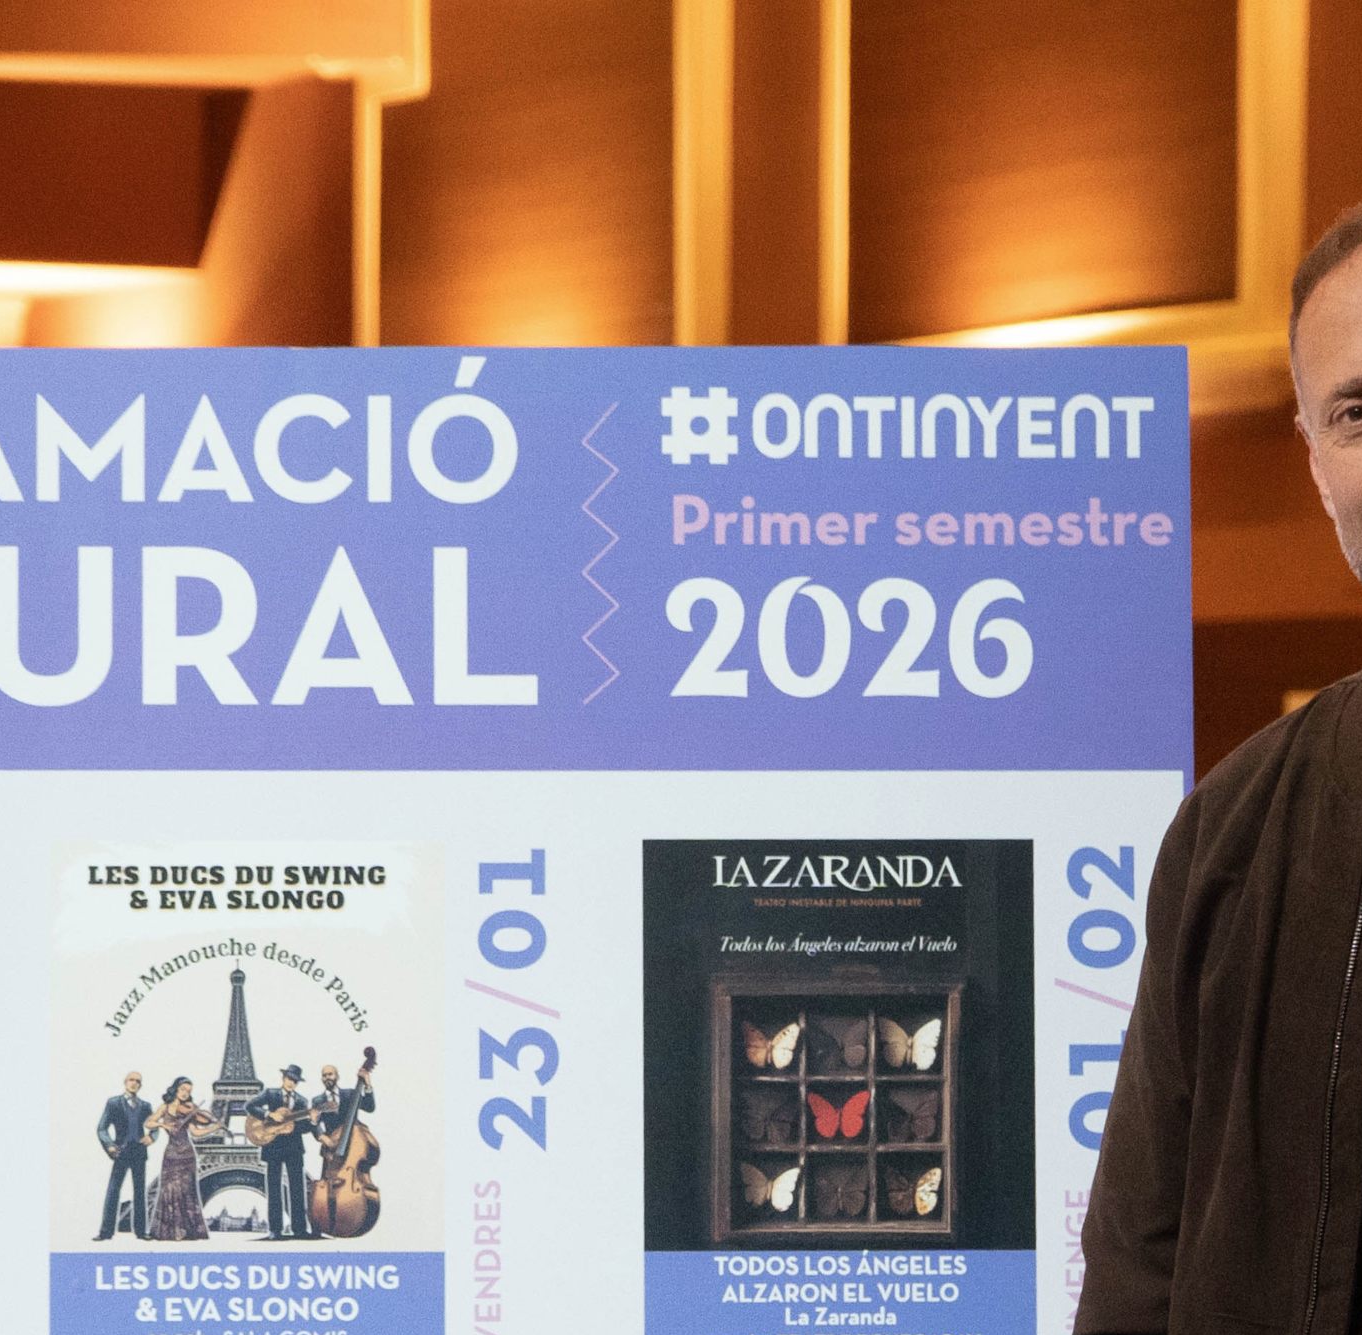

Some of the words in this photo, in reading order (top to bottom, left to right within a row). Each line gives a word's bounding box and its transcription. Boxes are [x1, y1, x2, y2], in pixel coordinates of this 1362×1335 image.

[672, 493, 879, 546] Primer
[895, 497, 1174, 546] semestre
[665, 575, 1034, 699] 2026
[88, 865, 140, 886] LES
[149, 865, 225, 886] DUCS
[235, 865, 274, 886] DU
[283, 865, 386, 886] SWING
[129, 889, 148, 910] &
[159, 890, 217, 910] EVA
[226, 889, 345, 910] SLONGO
[719, 935, 764, 953] Todos
[764, 935, 786, 953] los
[787, 931, 843, 957] Ángeles
[843, 935, 900, 953] alzaron
[900, 935, 917, 952] el
[917, 935, 958, 953] Vuelo
[103, 986, 145, 1038] Jazz
[138, 937, 257, 992] Manouche
[262, 942, 327, 983] desde
[324, 975, 370, 1033] Paris
[463, 848, 561, 1152] 23/01
[713, 1255, 800, 1277] TODOS
[804, 1255, 852, 1276] LOS
[856, 1249, 968, 1276] ÁNGELES
[95, 1265, 150, 1291] LES
[156, 1264, 242, 1291] DUCS
[247, 1264, 291, 1291] DU
[297, 1264, 400, 1290] SWING
[721, 1282, 838, 1304] ALZARON
[842, 1282, 872, 1303] EL
[876, 1282, 960, 1303] VUELO
[134, 1296, 158, 1322] &
[164, 1296, 222, 1322] EVA
[227, 1296, 360, 1322] SLONGO
[784, 1306, 810, 1326] La
[814, 1305, 898, 1326] Zaranda
